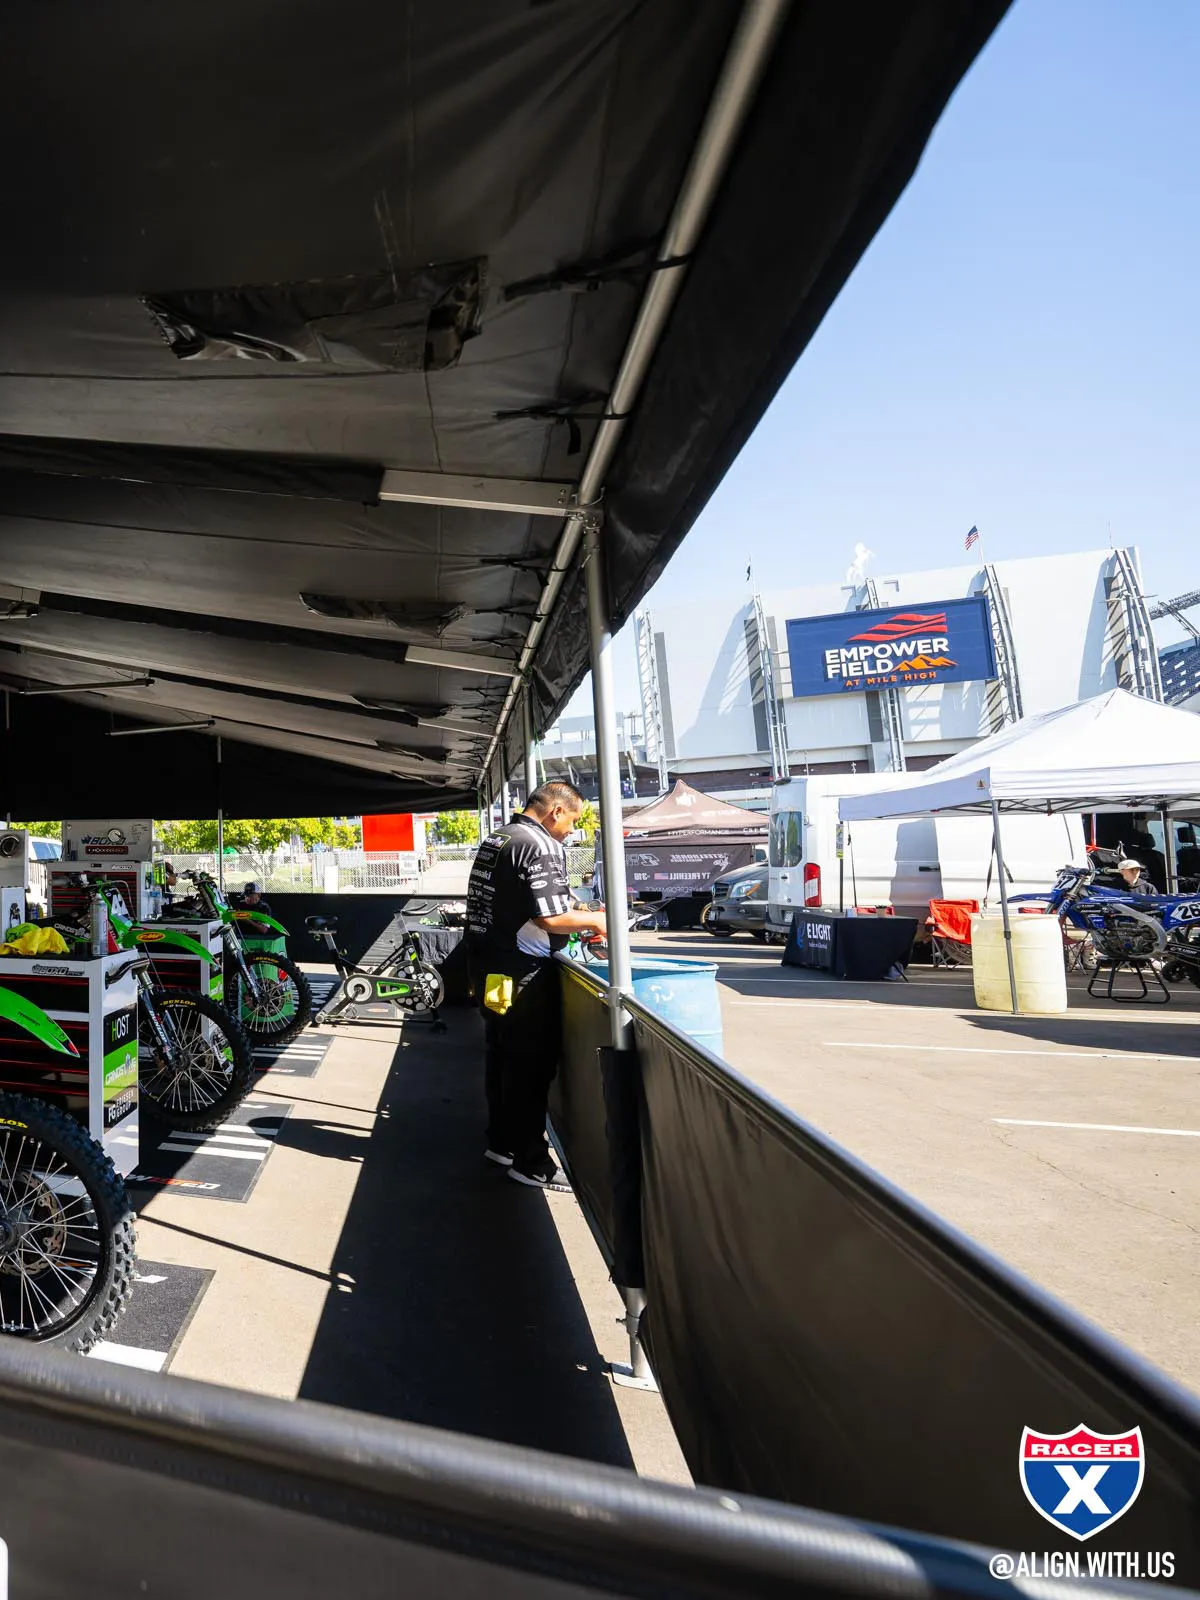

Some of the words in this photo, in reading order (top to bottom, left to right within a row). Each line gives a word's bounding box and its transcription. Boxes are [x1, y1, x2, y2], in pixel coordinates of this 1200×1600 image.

[825, 637, 949, 664] EMPOWER
[826, 658, 893, 679] FIELD
[867, 675, 897, 685] MILE
[904, 671, 937, 681] HIGH
[417, 972, 436, 1009] MARCY
[111, 1013, 130, 1042] HOST
